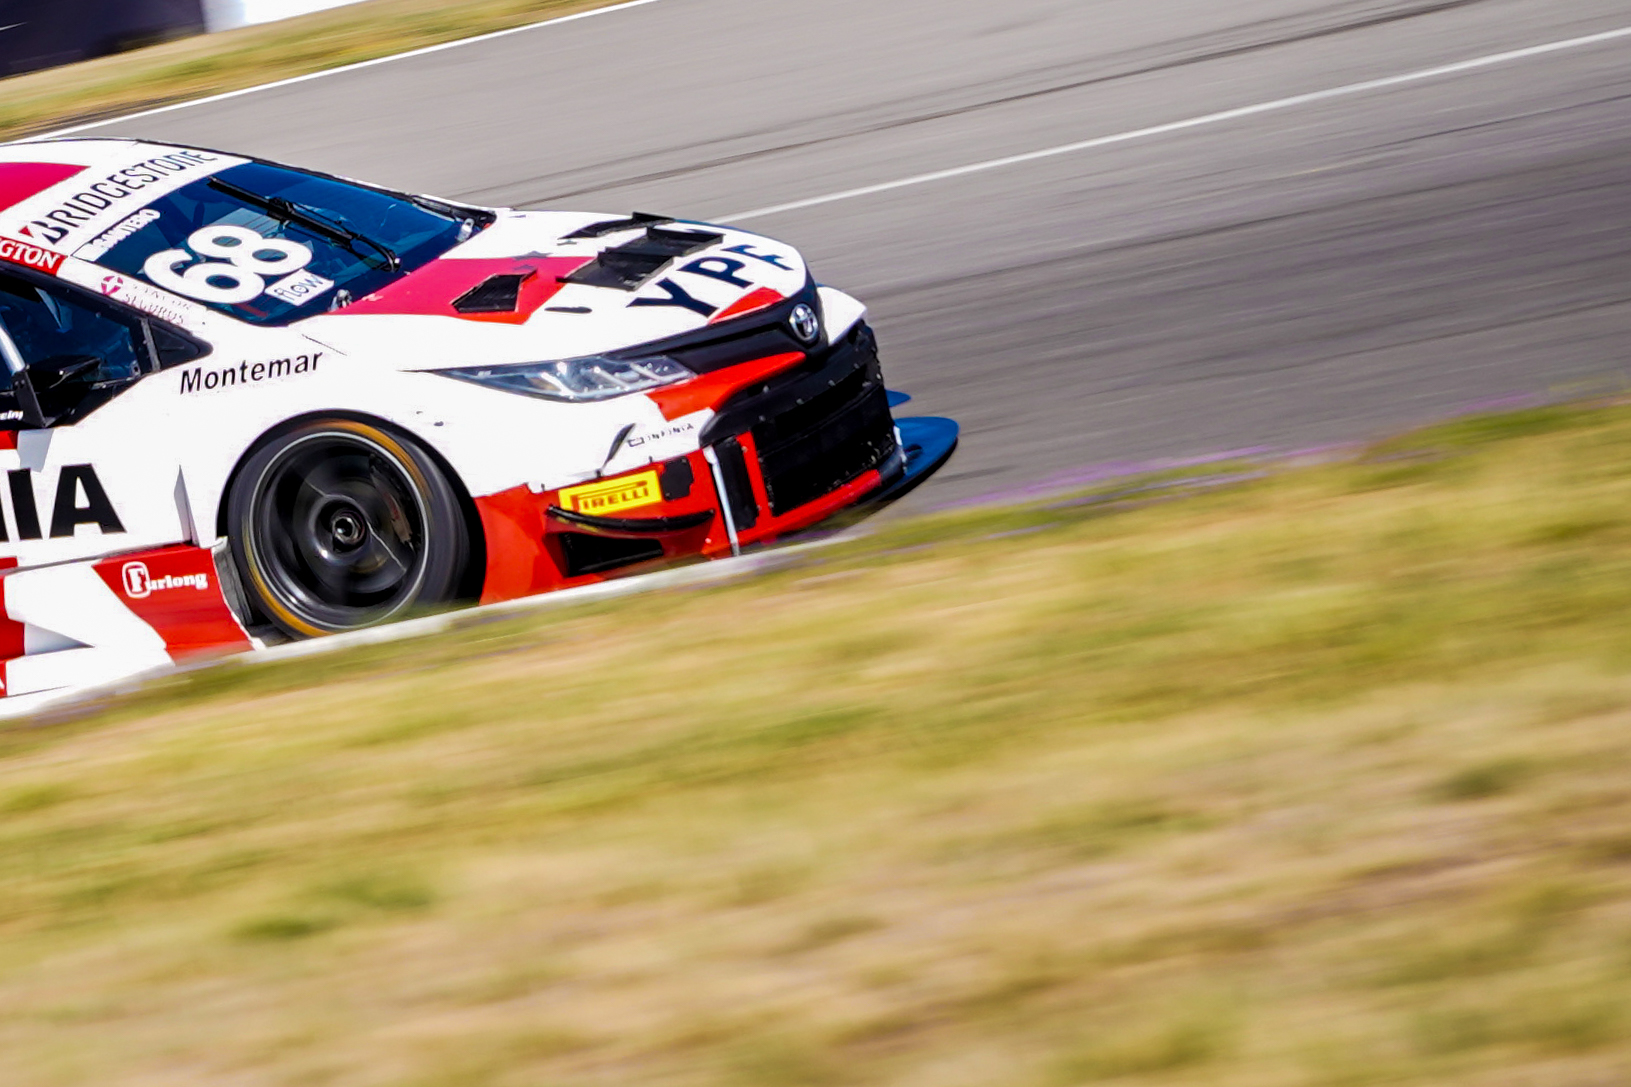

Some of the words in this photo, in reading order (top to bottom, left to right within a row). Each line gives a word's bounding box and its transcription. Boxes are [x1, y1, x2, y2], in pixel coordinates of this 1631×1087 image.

[31, 150, 218, 245] BRIDGESTONE
[143, 225, 313, 304] 68
[626, 244, 794, 318] YPF
[180, 352, 323, 395] Montemar
[570, 480, 649, 512] PIRELLI
[126, 567, 208, 593] Furlong
